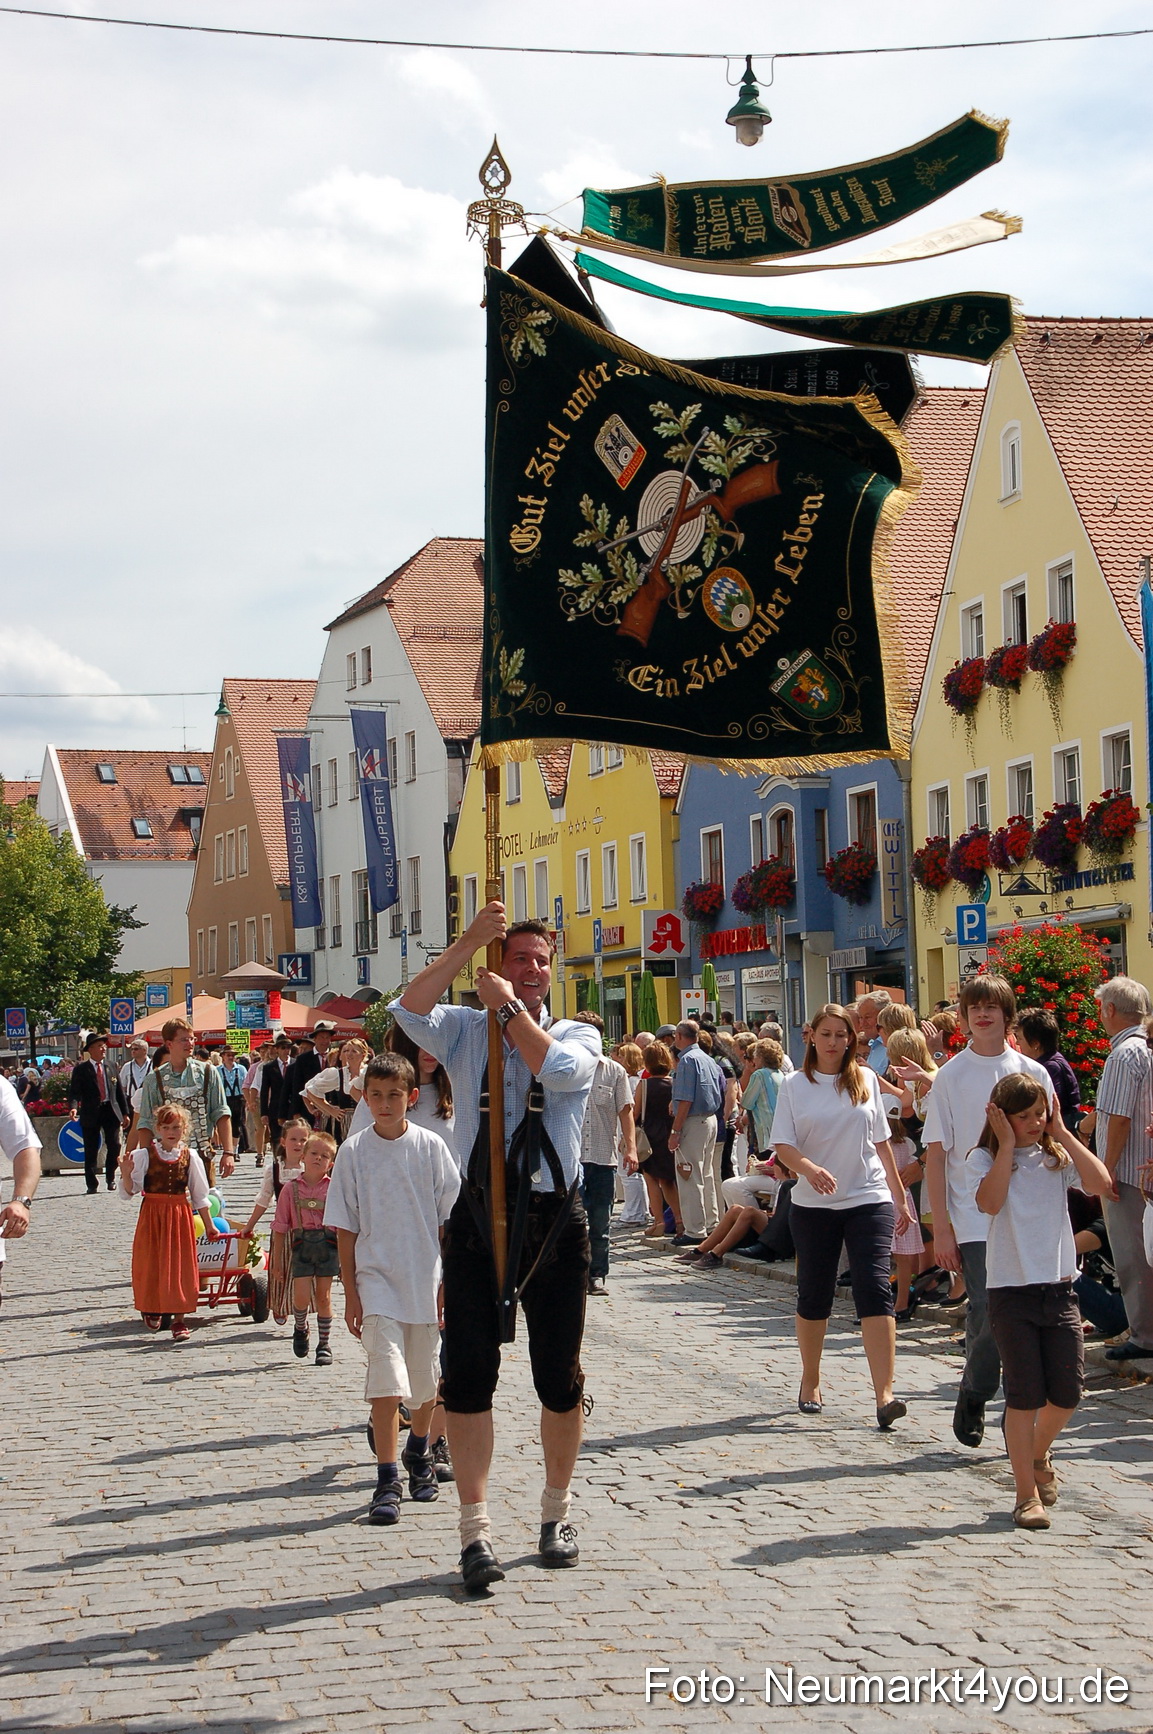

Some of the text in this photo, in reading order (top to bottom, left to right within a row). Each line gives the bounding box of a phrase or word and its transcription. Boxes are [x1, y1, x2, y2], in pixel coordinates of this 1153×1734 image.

[735, 196, 768, 243] Dank
[825, 368, 839, 391] 1988
[524, 420, 571, 488] Ziel
[509, 494, 548, 554] Gut
[627, 663, 681, 699] Ein
[773, 492, 825, 584] Leben
[373, 787, 393, 857] RUPPERT
[529, 827, 559, 851] Lehmeier
[963, 909, 980, 941] P
[765, 966, 780, 977] APOTHE
[8, 1028, 25, 1036] TAXI
[112, 1023, 133, 1033] TAXI
